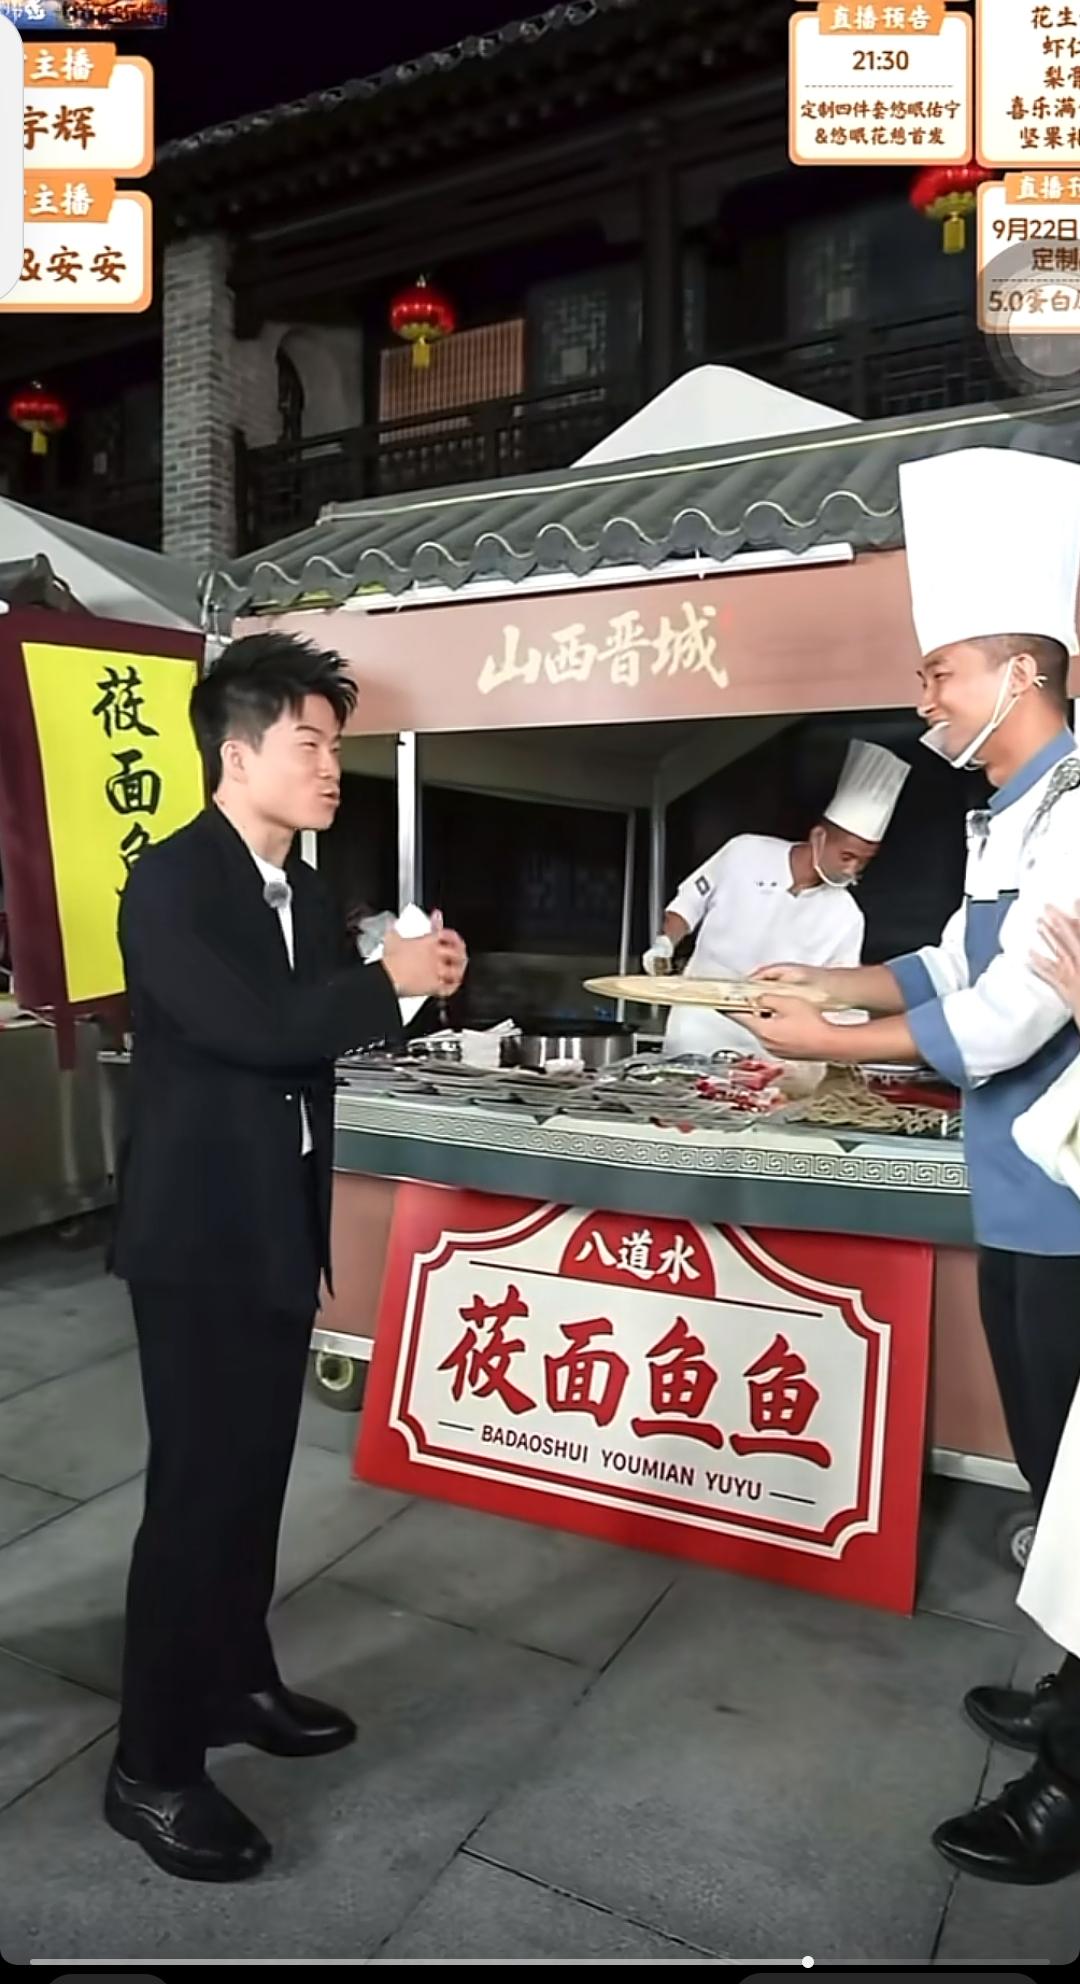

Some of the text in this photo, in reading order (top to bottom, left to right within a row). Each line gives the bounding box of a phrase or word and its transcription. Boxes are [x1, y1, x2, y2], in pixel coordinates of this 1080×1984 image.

[477, 601, 729, 694] 山西晋城
[574, 1228, 701, 1284] 八道水
[436, 1284, 832, 1469] 莜面鱼鱼
[481, 1425, 761, 1501] BADAOSHUI YOUMIAN YUYU
